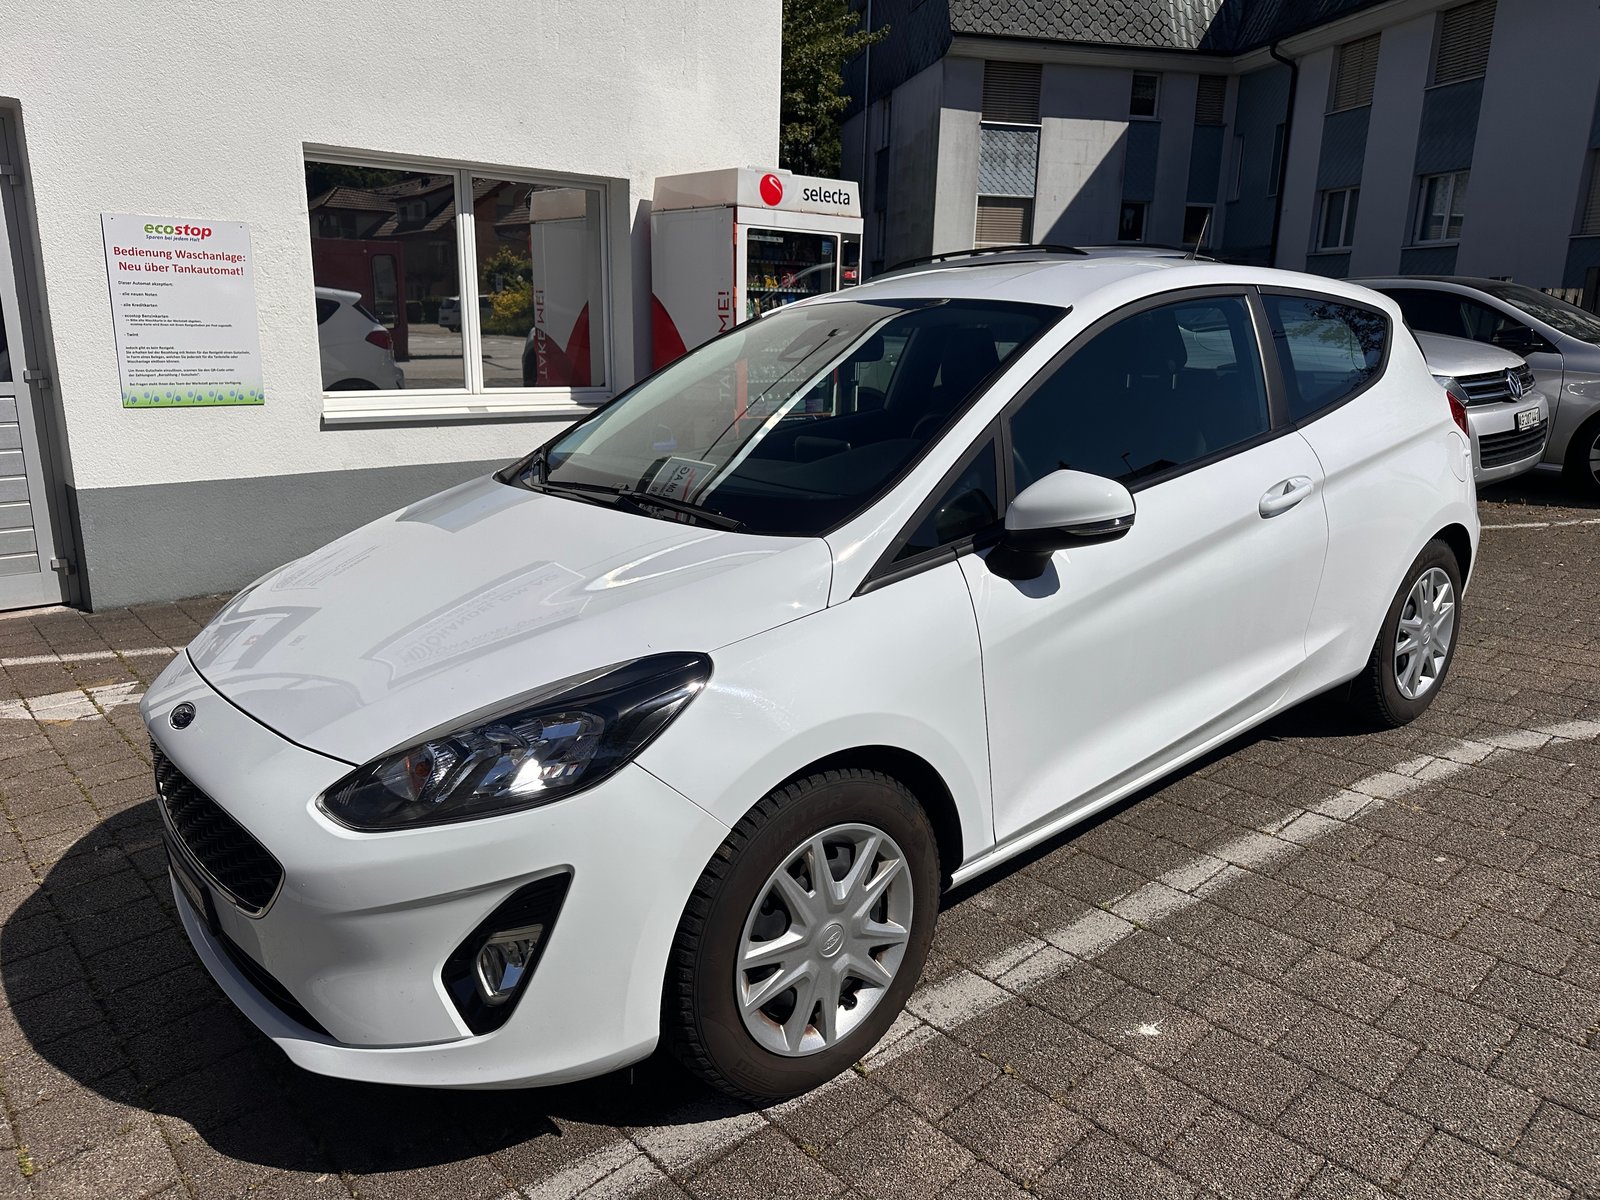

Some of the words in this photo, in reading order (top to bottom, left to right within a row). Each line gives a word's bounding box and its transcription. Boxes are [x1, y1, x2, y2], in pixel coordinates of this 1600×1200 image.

[803, 186, 850, 205] selecta
[144, 223, 212, 240] ecostop
[113, 246, 173, 260] Bedienung
[175, 249, 246, 263] Waschanlage:
[119, 261, 141, 271] Neu
[144, 262, 169, 273] über
[172, 263, 244, 276] Tankautomat!
[718, 291, 729, 333] ME!
